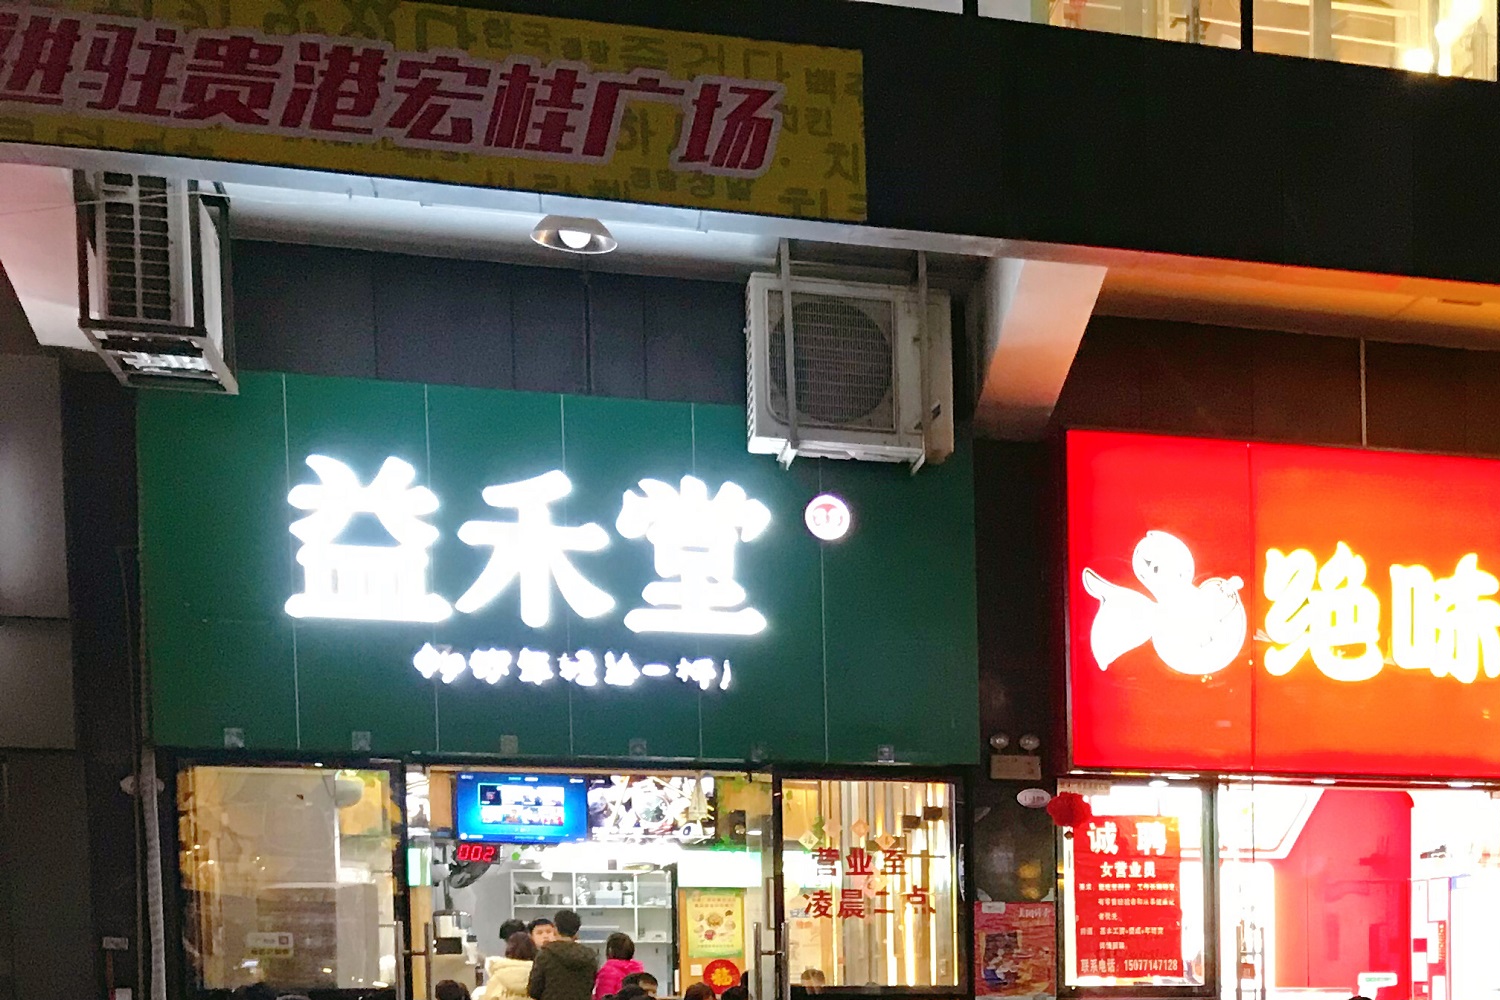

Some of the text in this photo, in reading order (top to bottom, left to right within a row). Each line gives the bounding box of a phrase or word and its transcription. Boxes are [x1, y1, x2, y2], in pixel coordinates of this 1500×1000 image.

[0, 12, 780, 172] 进驻贵港宏桂广场
[284, 453, 772, 635] 益禾堂
[457, 844, 495, 862] 002
[1087, 821, 1167, 855] 诚聘
[812, 846, 907, 877] 营业至
[1100, 861, 1156, 878] 女营业员
[802, 884, 937, 920] 凌晨二点
[1124, 959, 1178, 972] 15077147128
